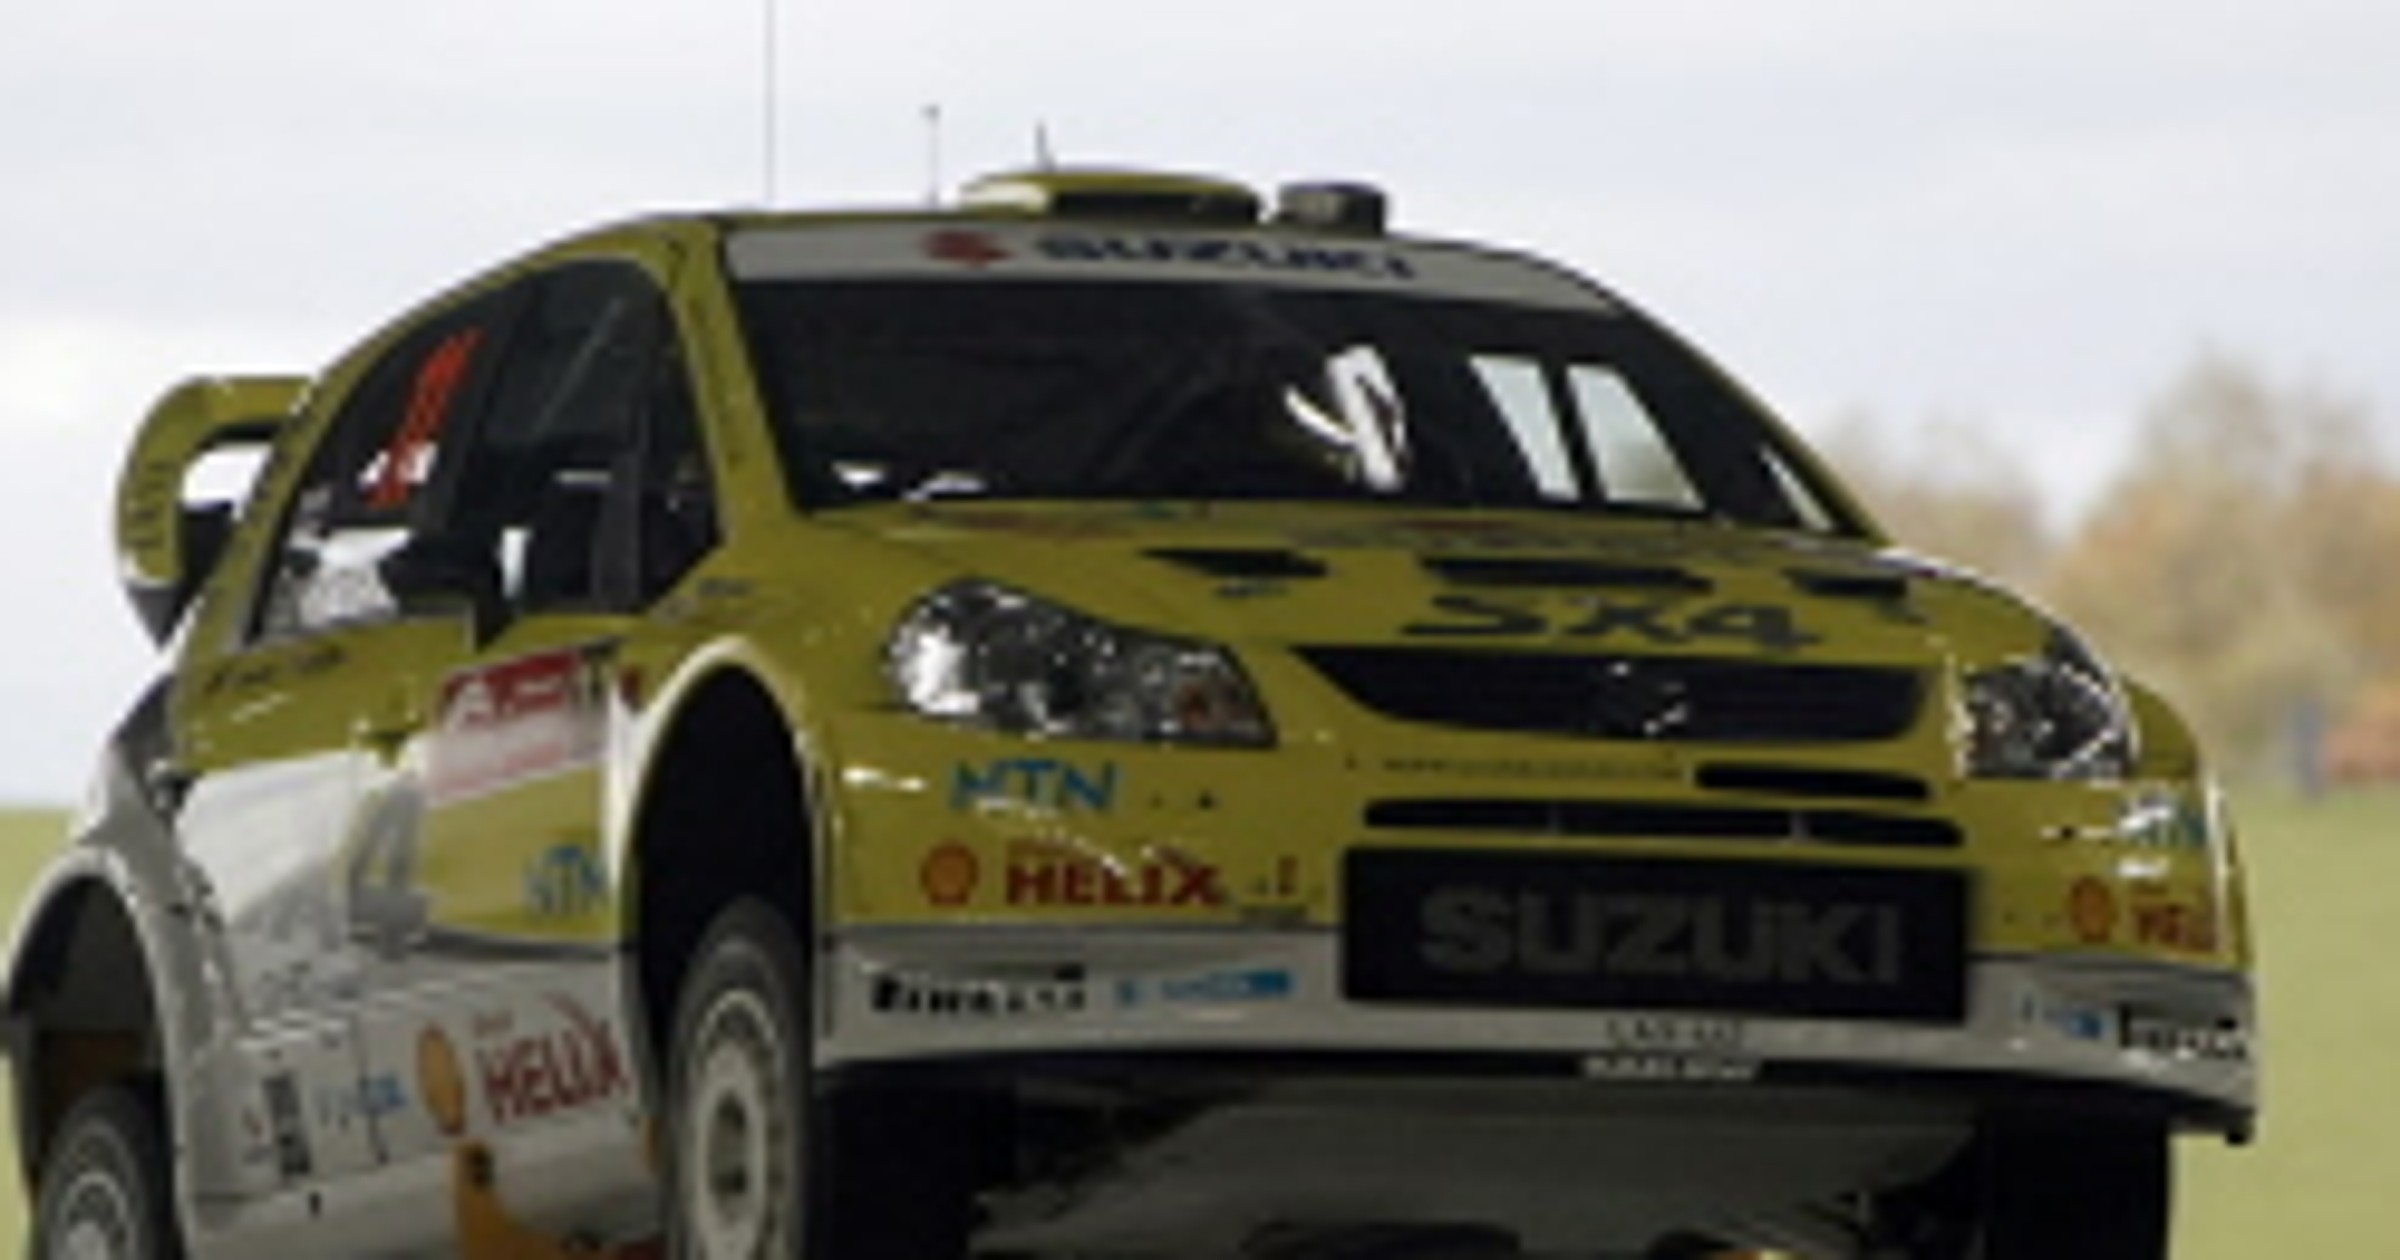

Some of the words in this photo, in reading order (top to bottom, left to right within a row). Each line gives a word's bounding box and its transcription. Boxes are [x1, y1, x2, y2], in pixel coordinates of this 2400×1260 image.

[1036, 232, 1414, 280] SUZUKI
[1400, 592, 1822, 652] SX4
[1004, 852, 1228, 906] HELIX
[1420, 887, 1904, 984] SUZUKI
[474, 1002, 630, 1126] HELIX
